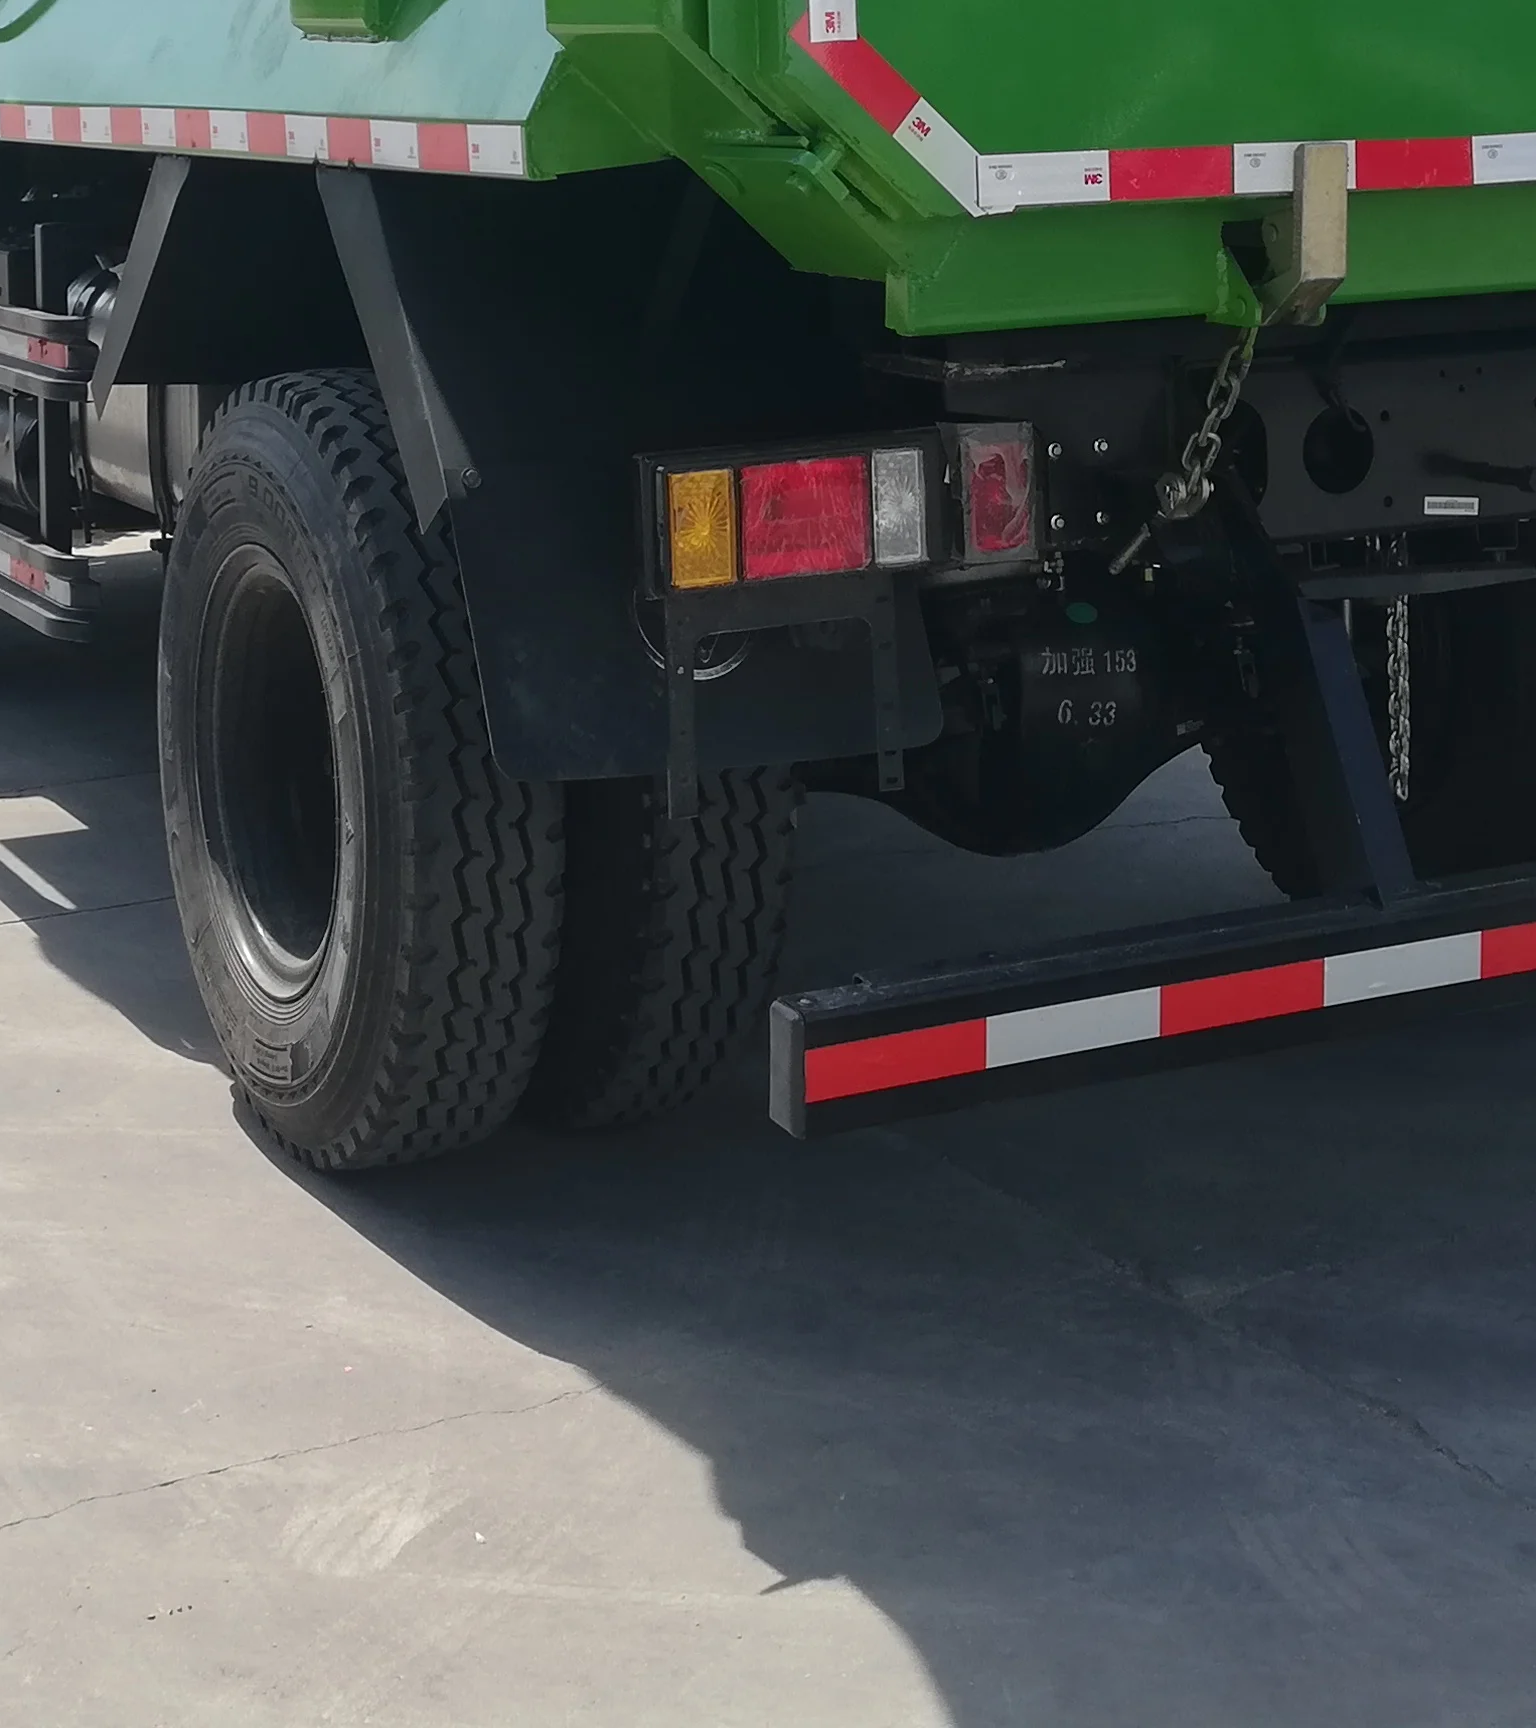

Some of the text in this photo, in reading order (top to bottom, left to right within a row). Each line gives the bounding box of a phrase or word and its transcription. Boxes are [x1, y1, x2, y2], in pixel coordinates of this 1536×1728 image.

[824, 11, 835, 34] 3M
[912, 116, 931, 137] 3M
[1084, 173, 1103, 185] 3M
[1040, 645, 1138, 677] 加强 153
